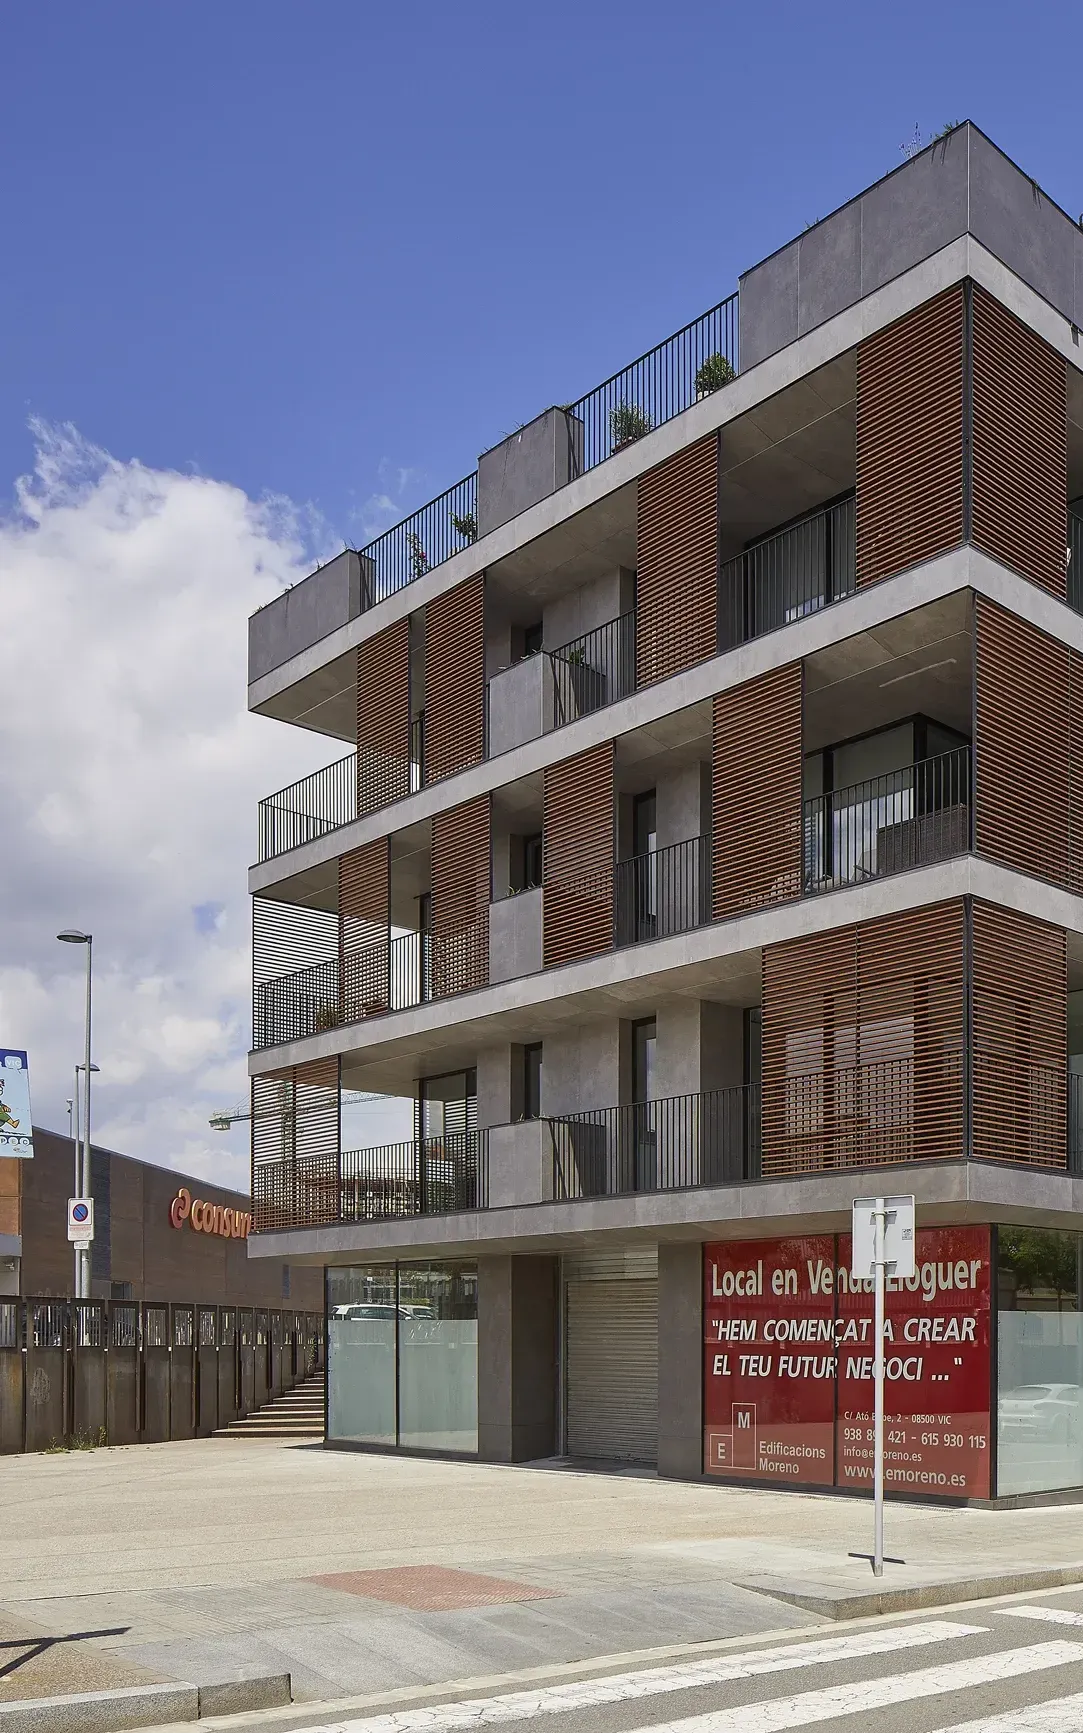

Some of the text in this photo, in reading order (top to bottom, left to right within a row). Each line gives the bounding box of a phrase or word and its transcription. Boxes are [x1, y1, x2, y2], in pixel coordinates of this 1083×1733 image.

[712, 1259, 763, 1297] Local
[772, 1268, 798, 1296] en
[763, 1318, 872, 1348] COMENÇAT
[903, 1317, 976, 1341] CREAR
[712, 1354, 731, 1376] EL
[739, 1355, 772, 1377] TEU
[778, 1356, 838, 1379] FUTUR
[737, 1411, 750, 1429] M
[844, 1411, 853, 1420] C/
[855, 1411, 869, 1421] Ató
[896, 1413, 902, 1423] 2
[911, 1414, 935, 1424] 08500
[937, 1415, 952, 1425] VIC
[844, 1428, 862, 1441] 938
[887, 1430, 907, 1444] 421
[921, 1432, 939, 1446] 615
[943, 1434, 964, 1447] 930
[968, 1435, 986, 1449] 115
[717, 1442, 726, 1460] E
[759, 1440, 826, 1459] Edificacions
[843, 1446, 922, 1462] info@eoreno.es
[759, 1457, 800, 1475] Moreno
